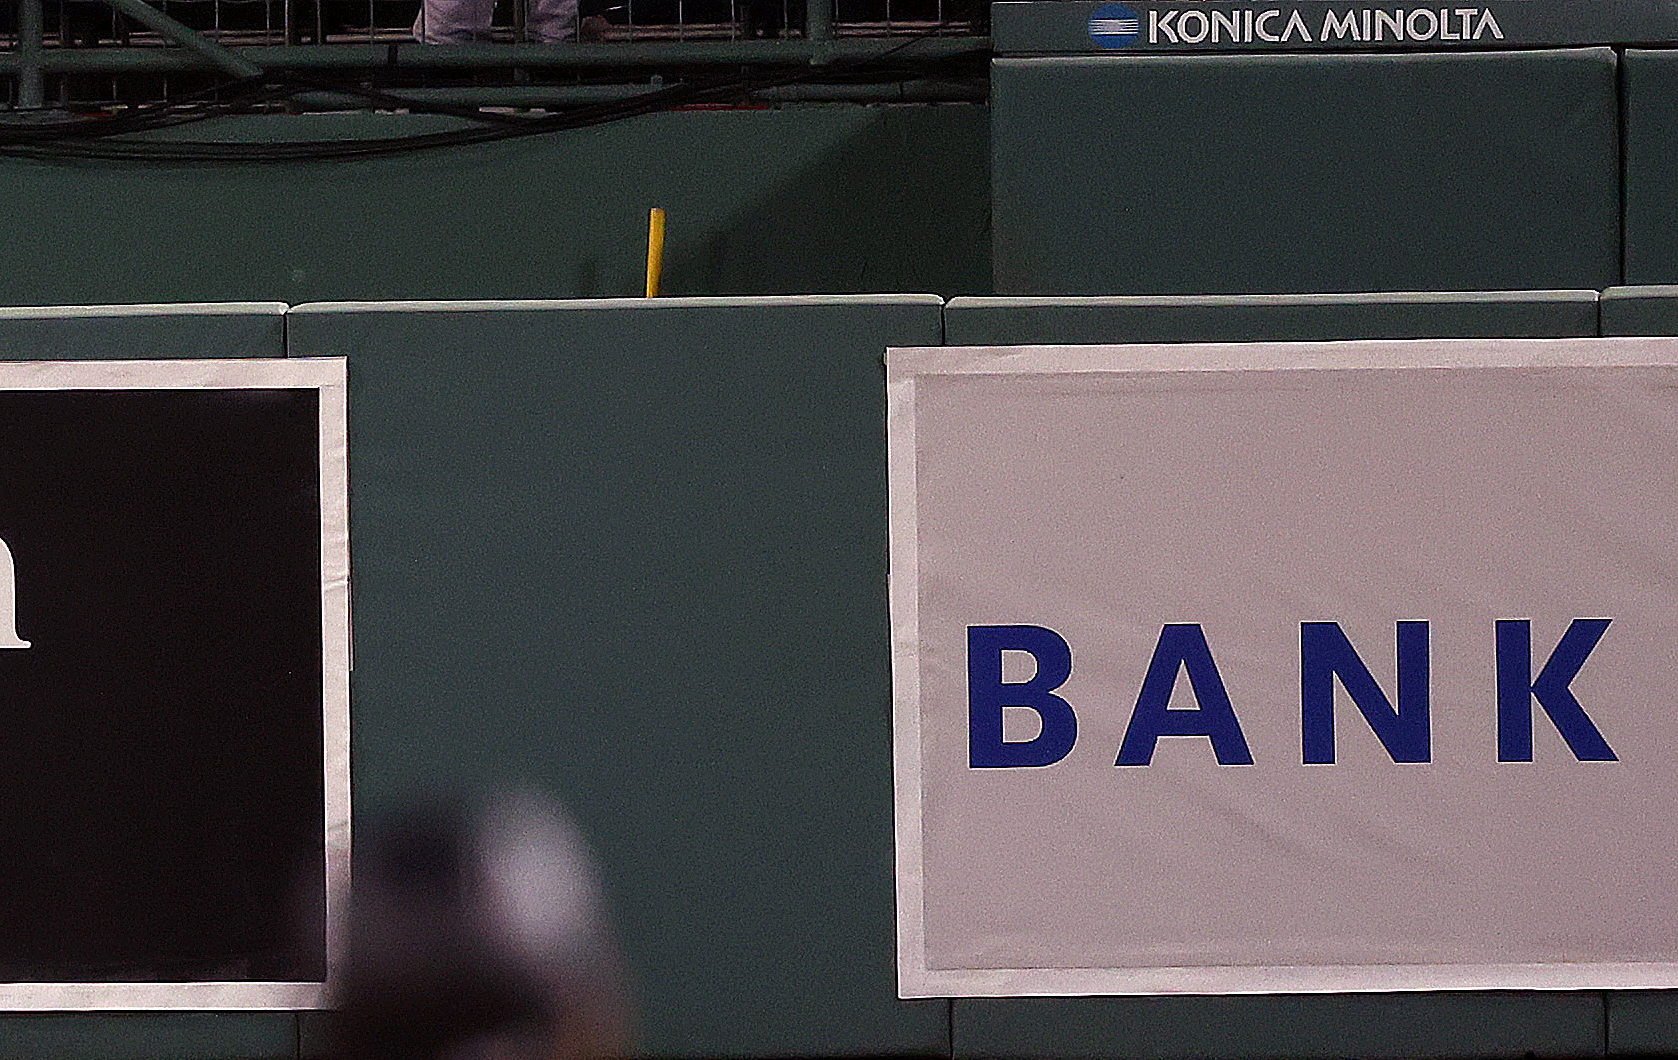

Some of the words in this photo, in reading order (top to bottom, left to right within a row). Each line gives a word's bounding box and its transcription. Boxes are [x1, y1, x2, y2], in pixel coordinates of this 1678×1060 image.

[1148, 9, 1312, 44] KONICA
[1320, 8, 1505, 42] MINOLTA
[966, 617, 1621, 770] BANK
